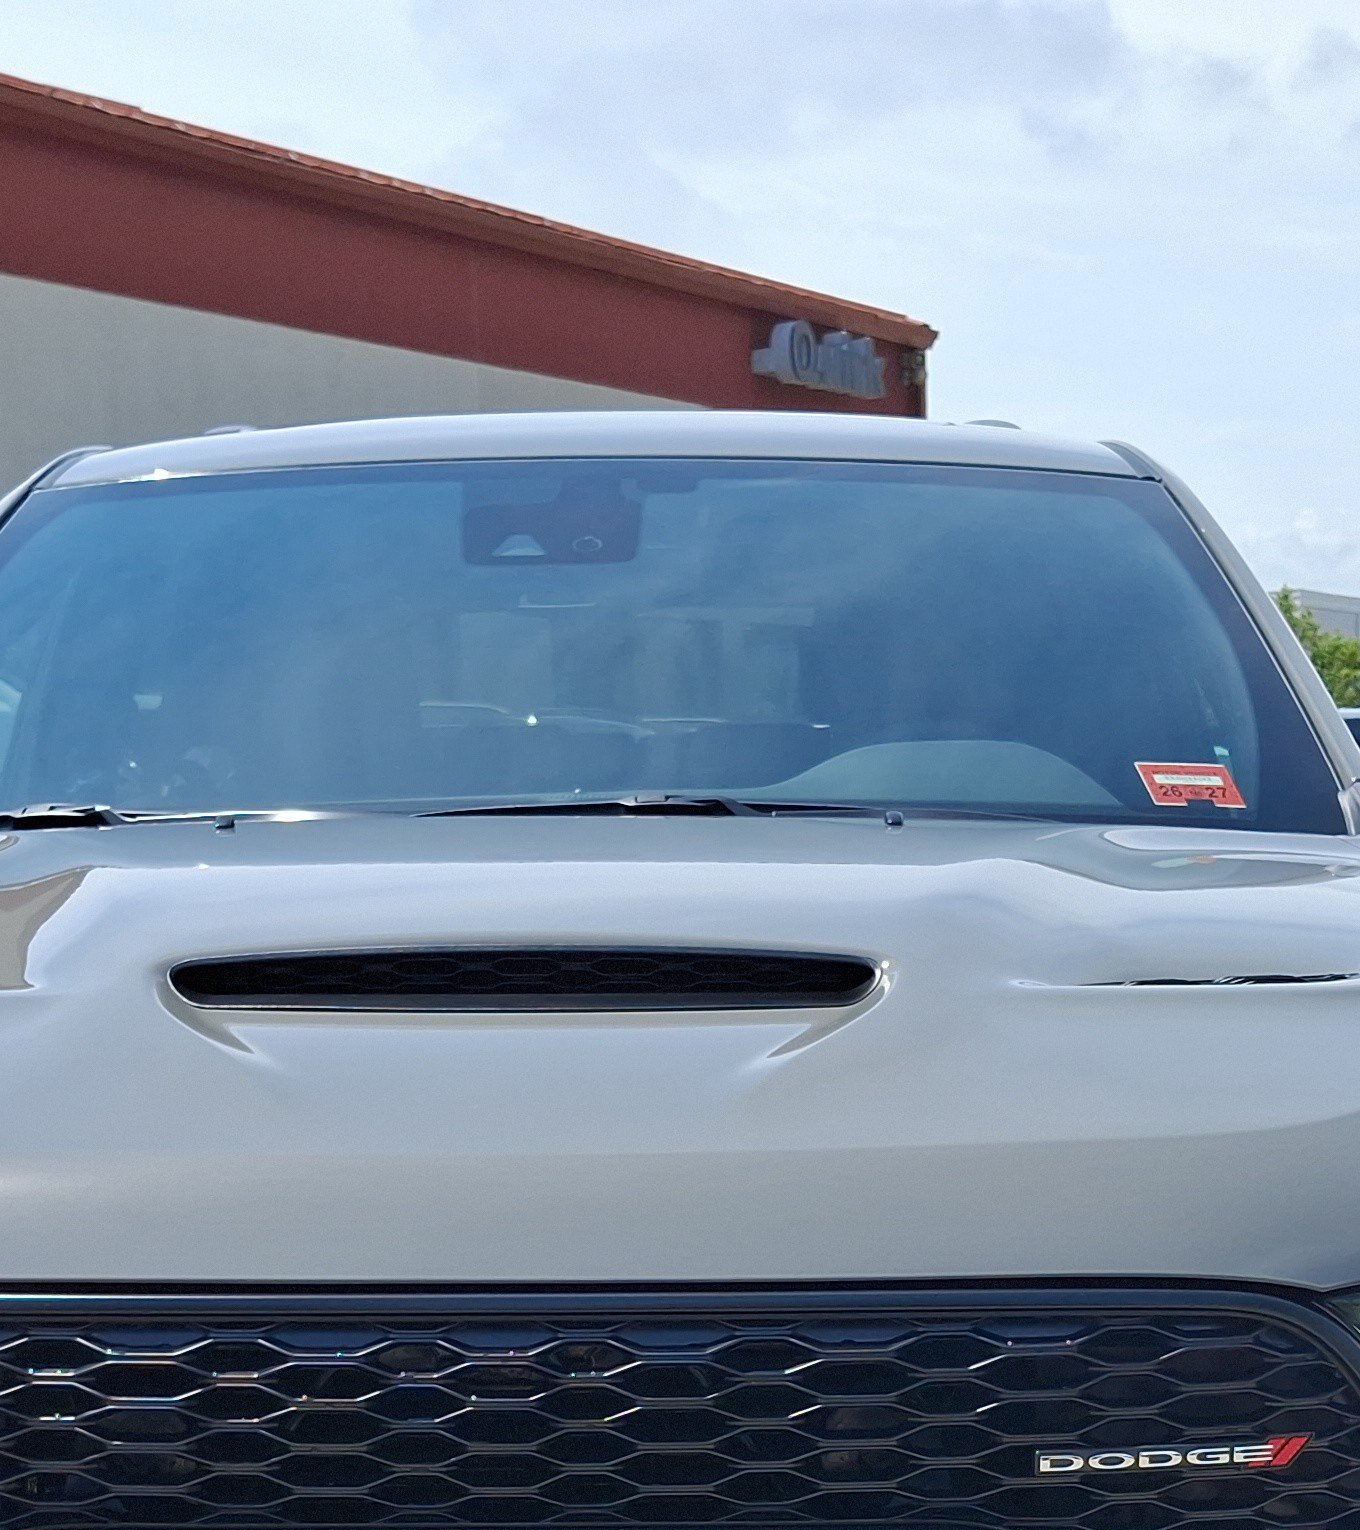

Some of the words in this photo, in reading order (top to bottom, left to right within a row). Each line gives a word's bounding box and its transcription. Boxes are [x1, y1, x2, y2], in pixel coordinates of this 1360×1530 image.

[1159, 785, 1182, 797] 26
[1205, 787, 1226, 798] 27
[1039, 1445, 1273, 1472] DODGE
